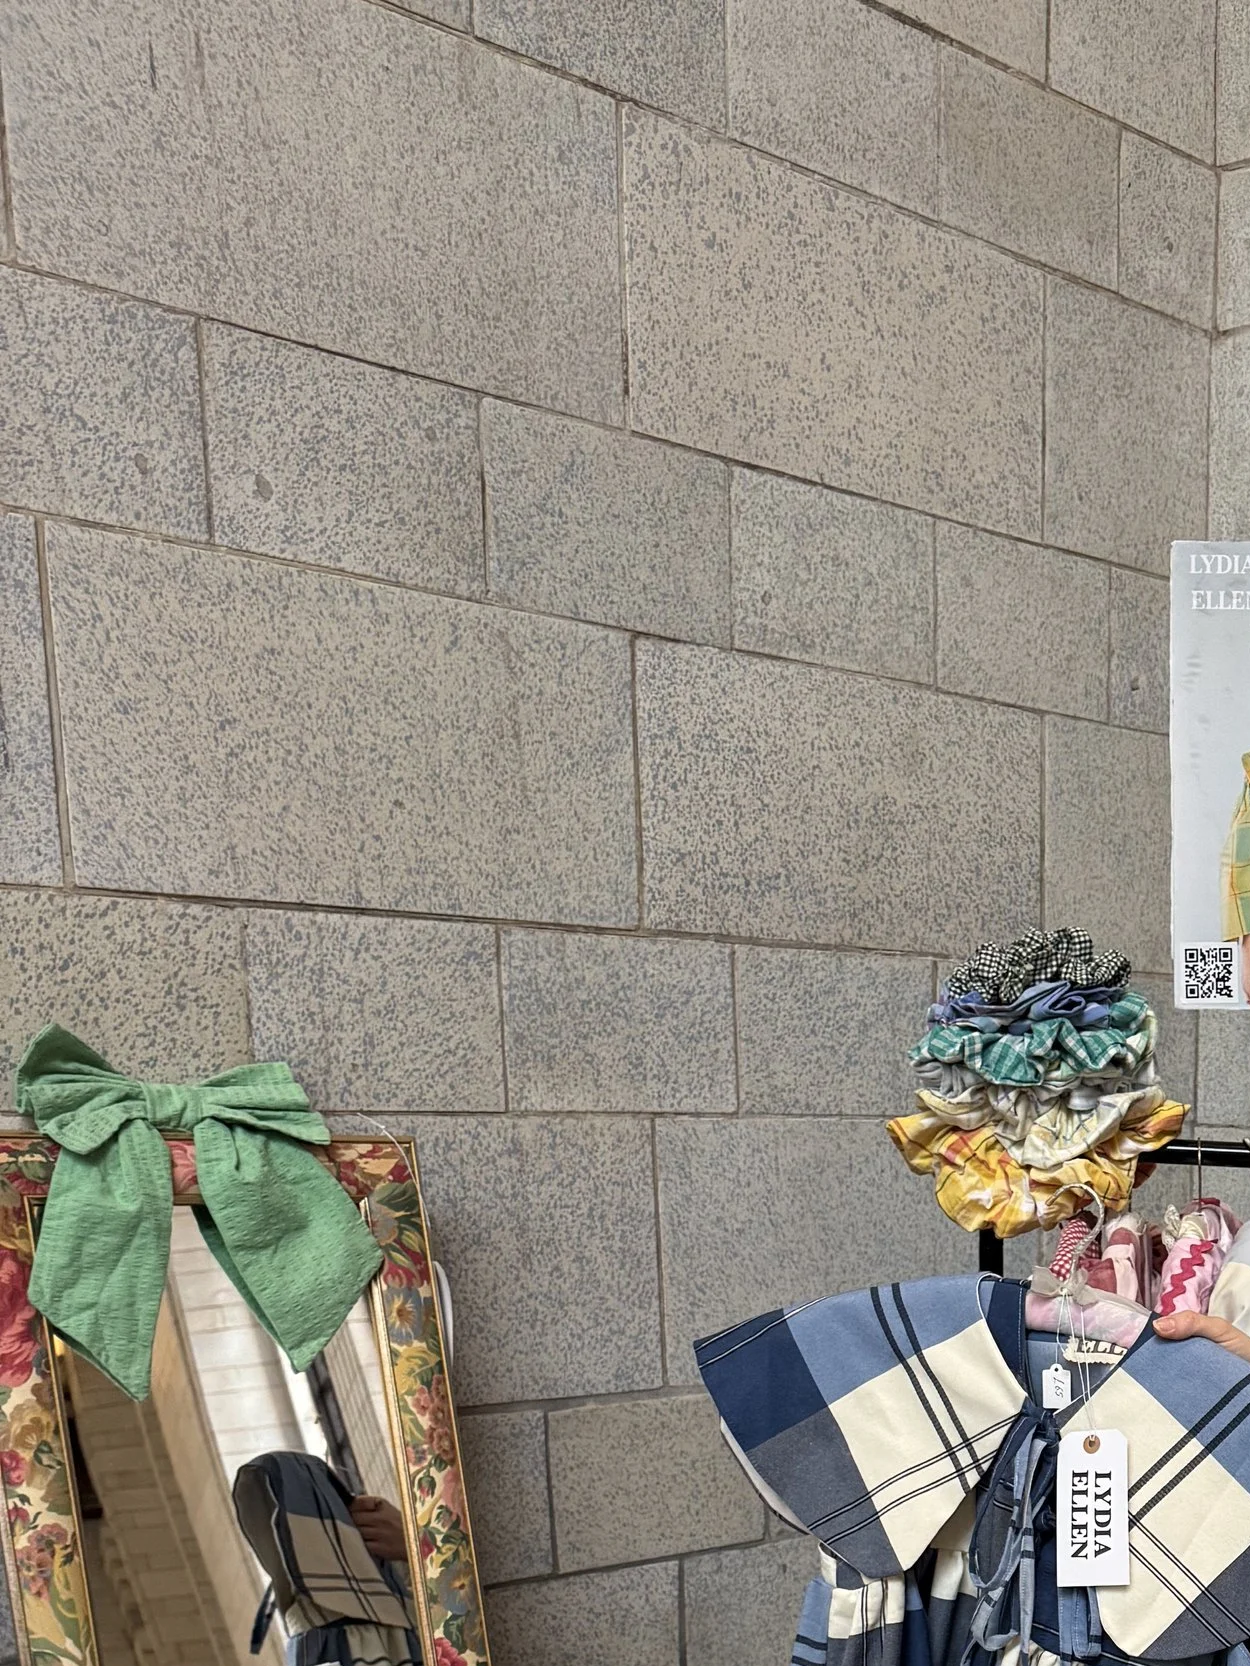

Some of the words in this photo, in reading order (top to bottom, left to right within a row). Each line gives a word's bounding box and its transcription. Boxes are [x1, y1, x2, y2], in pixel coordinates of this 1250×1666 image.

[1076, 1338, 1125, 1356] ELL
[1071, 1470, 1089, 1560] ELLEN
[1094, 1470, 1112, 1559] LYDIA
